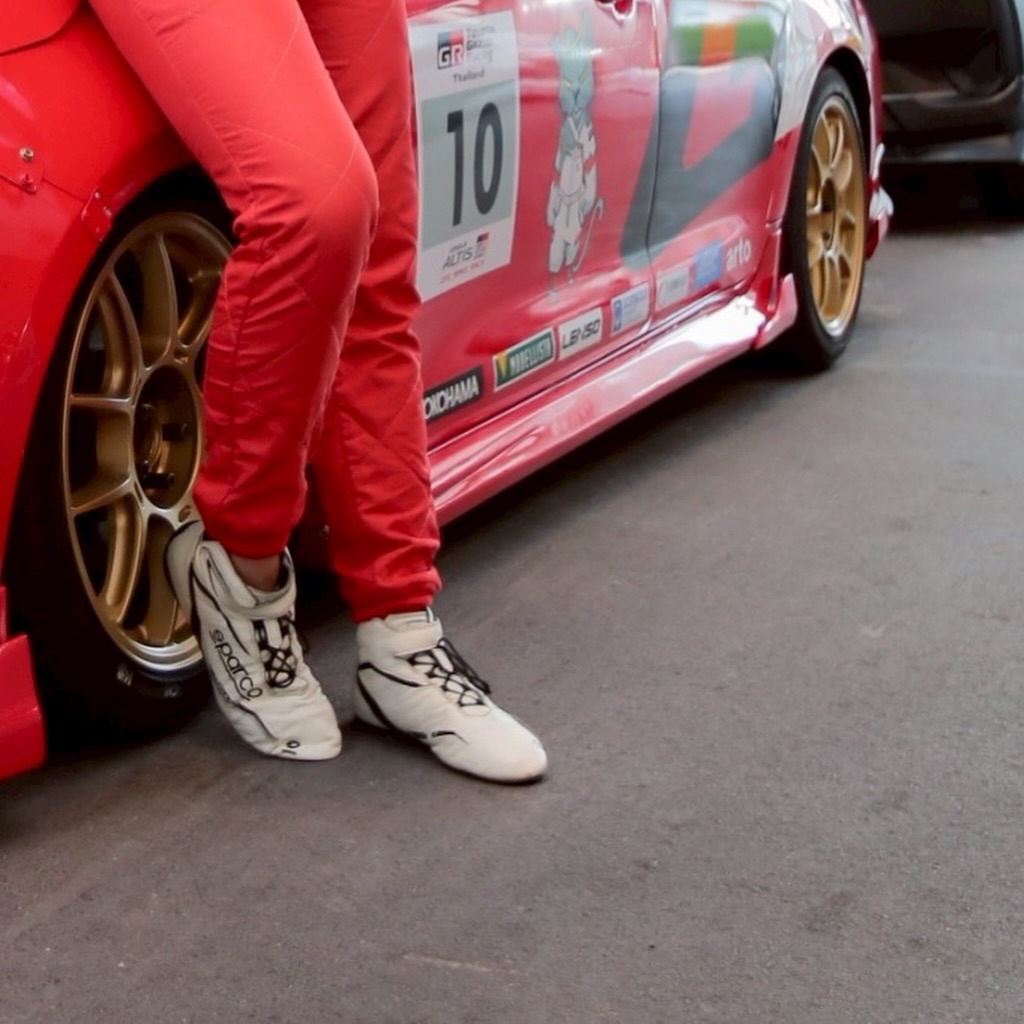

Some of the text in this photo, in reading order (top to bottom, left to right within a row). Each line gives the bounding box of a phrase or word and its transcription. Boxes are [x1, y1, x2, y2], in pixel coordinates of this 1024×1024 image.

[439, 45, 463, 68] GR
[447, 102, 503, 227] 10
[424, 375, 479, 418] OKOHAMA
[209, 628, 263, 699] sparco
